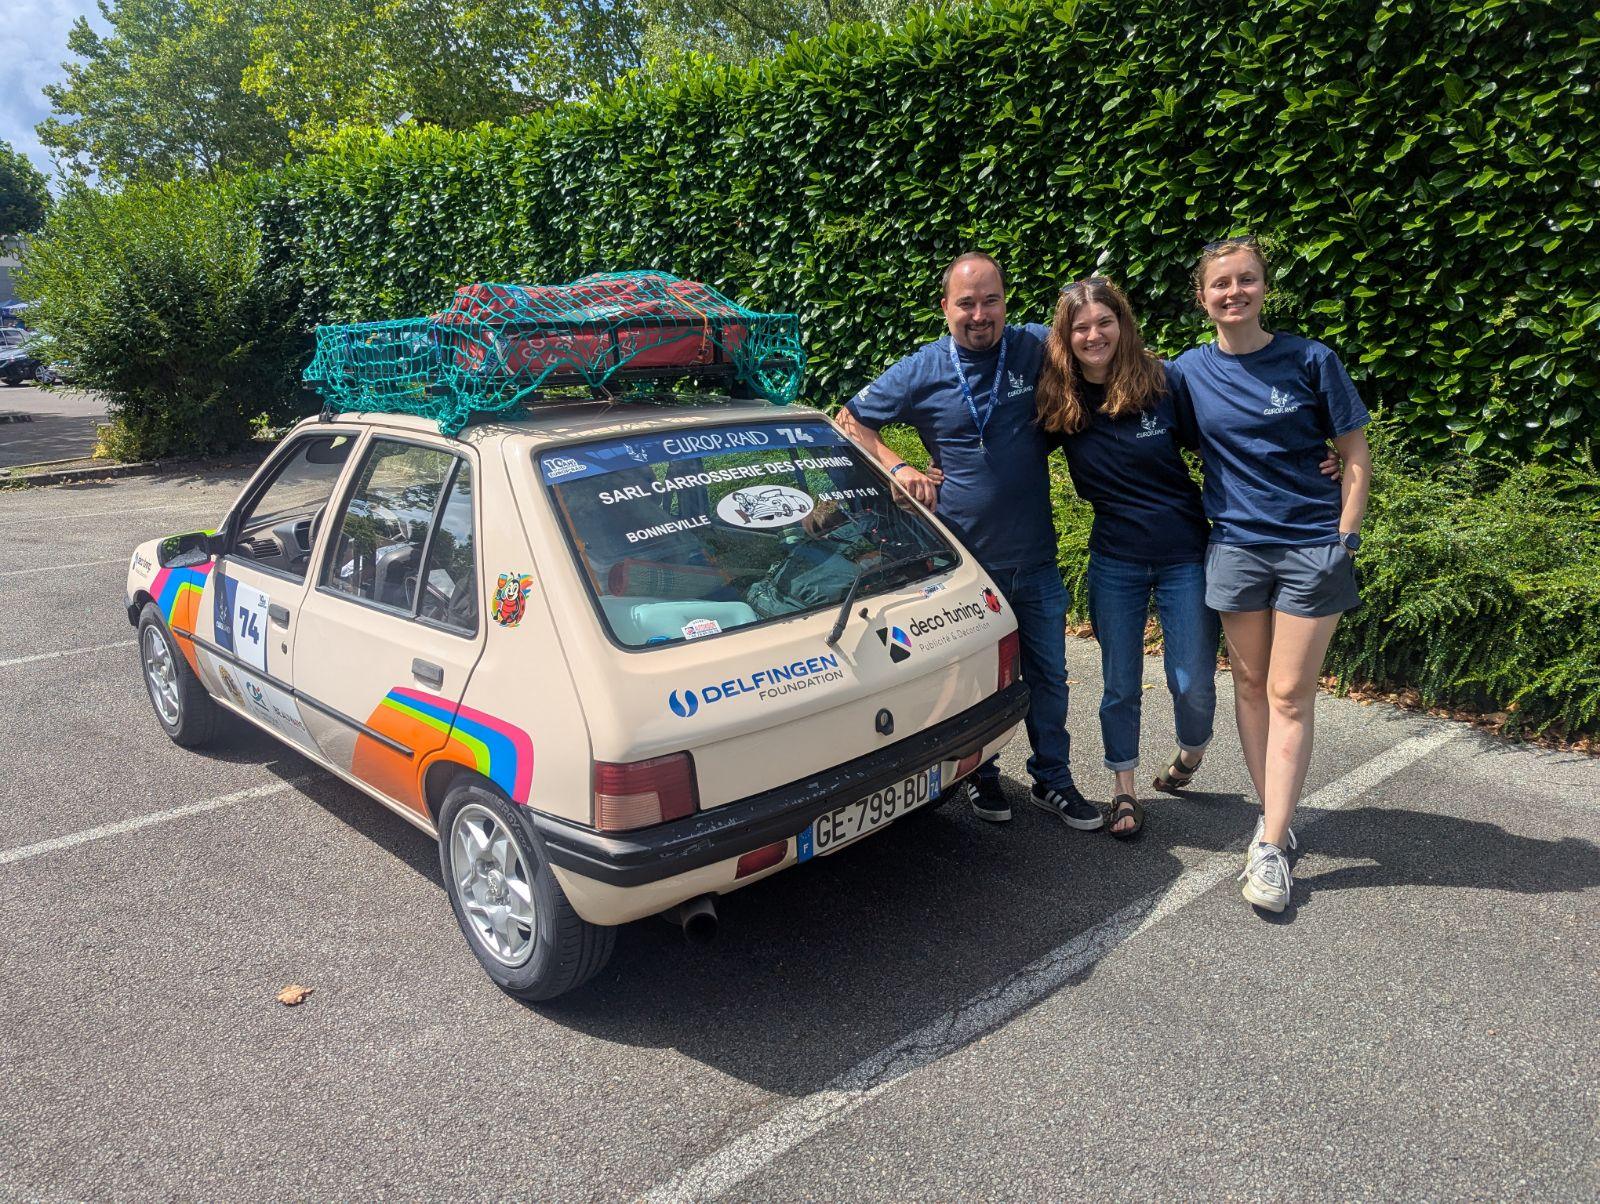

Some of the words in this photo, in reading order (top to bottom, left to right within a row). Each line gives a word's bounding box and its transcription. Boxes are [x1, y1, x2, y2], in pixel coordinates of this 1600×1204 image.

[662, 431, 769, 455] EUROP.RAID
[776, 427, 815, 444] 74
[598, 485, 651, 505] SARL
[651, 464, 766, 494] CARROSSERIE
[764, 461, 796, 475] DES
[794, 456, 854, 471] FOURMIS
[818, 492, 833, 502] 04
[831, 491, 845, 500] 50
[843, 489, 856, 499] 97
[855, 488, 868, 497] 11
[625, 514, 712, 544] BONNEVILLE
[239, 605, 260, 646] 74
[909, 617, 946, 637] deco
[701, 653, 839, 704] DELFINGEN
[758, 669, 844, 701] FOUNDATION
[930, 781, 939, 797] 74
[816, 771, 928, 848] GE-799-BD
[803, 843, 809, 854] F
